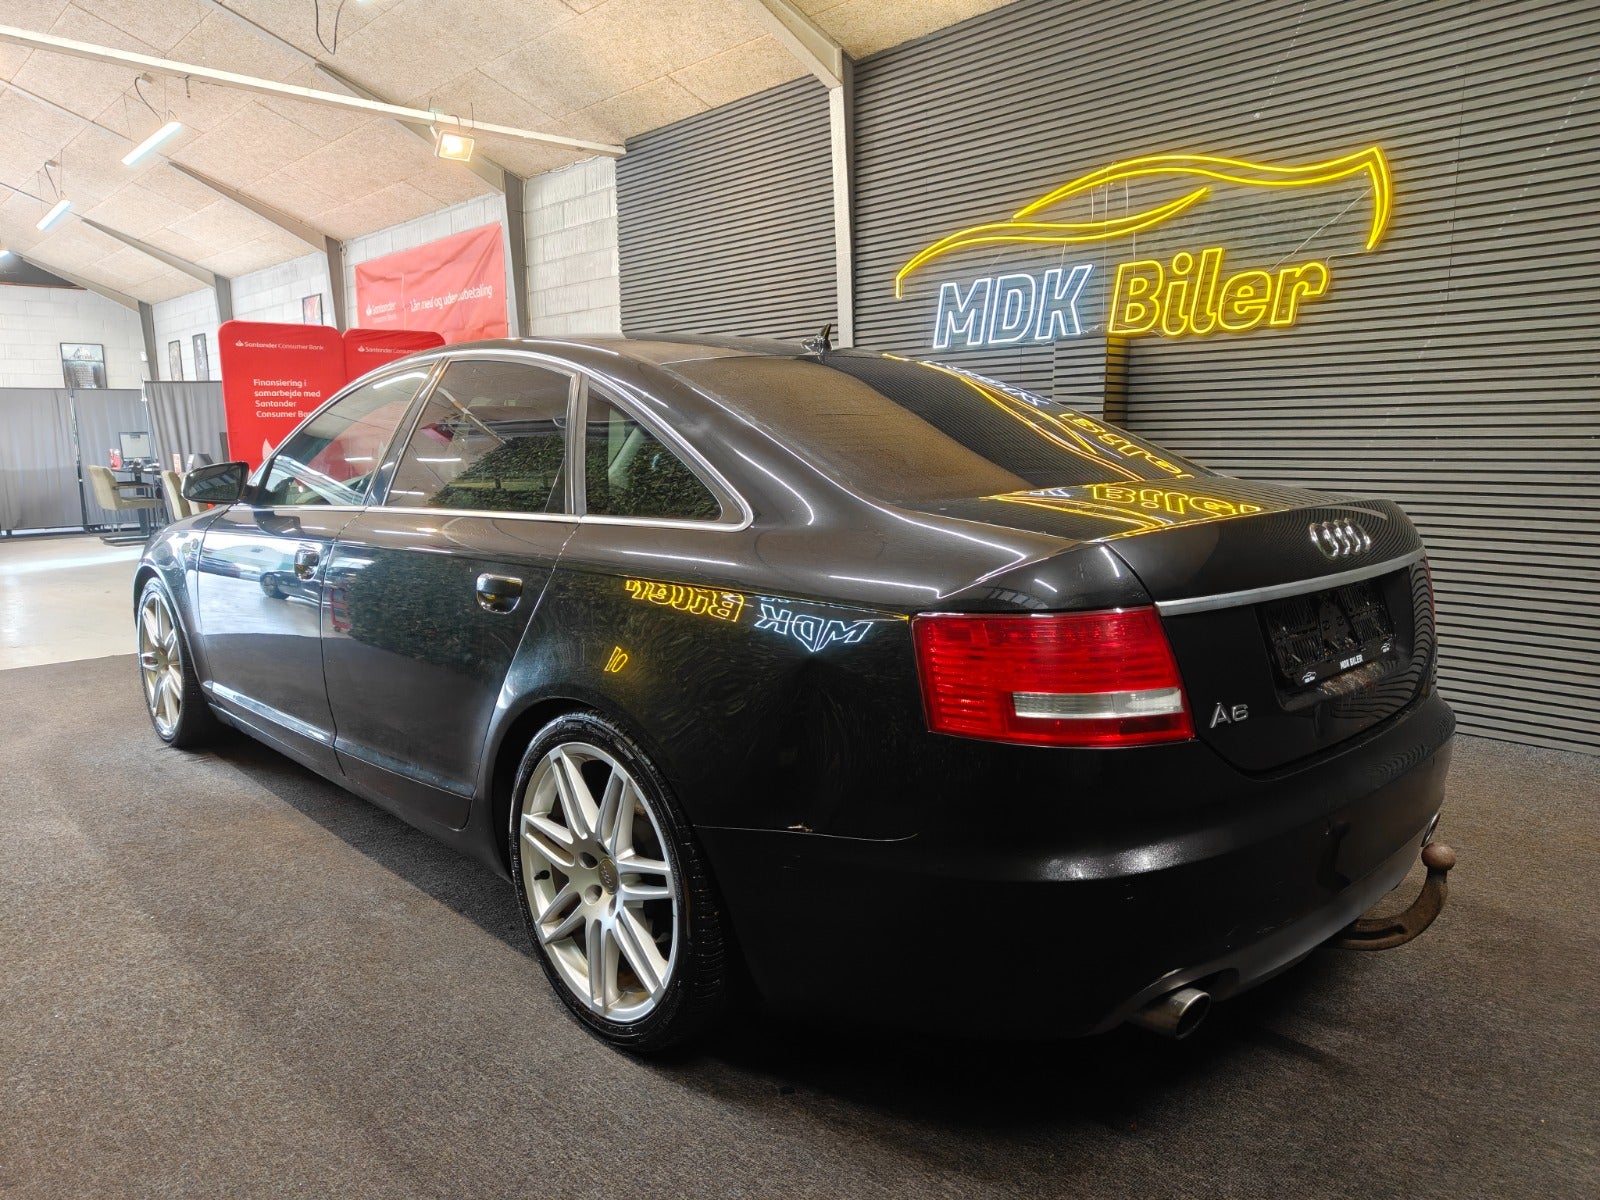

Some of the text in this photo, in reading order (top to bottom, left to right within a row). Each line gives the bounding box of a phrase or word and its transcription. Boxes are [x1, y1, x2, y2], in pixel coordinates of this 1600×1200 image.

[933, 247, 1331, 350] MDK Biler
[244, 341, 277, 349] Santander
[253, 379, 307, 388] Finansiering i
[254, 390, 321, 398] samarbejde med
[255, 400, 297, 408] Santander
[256, 410, 310, 418] Consumer Ba
[1209, 702, 1249, 729] A6
